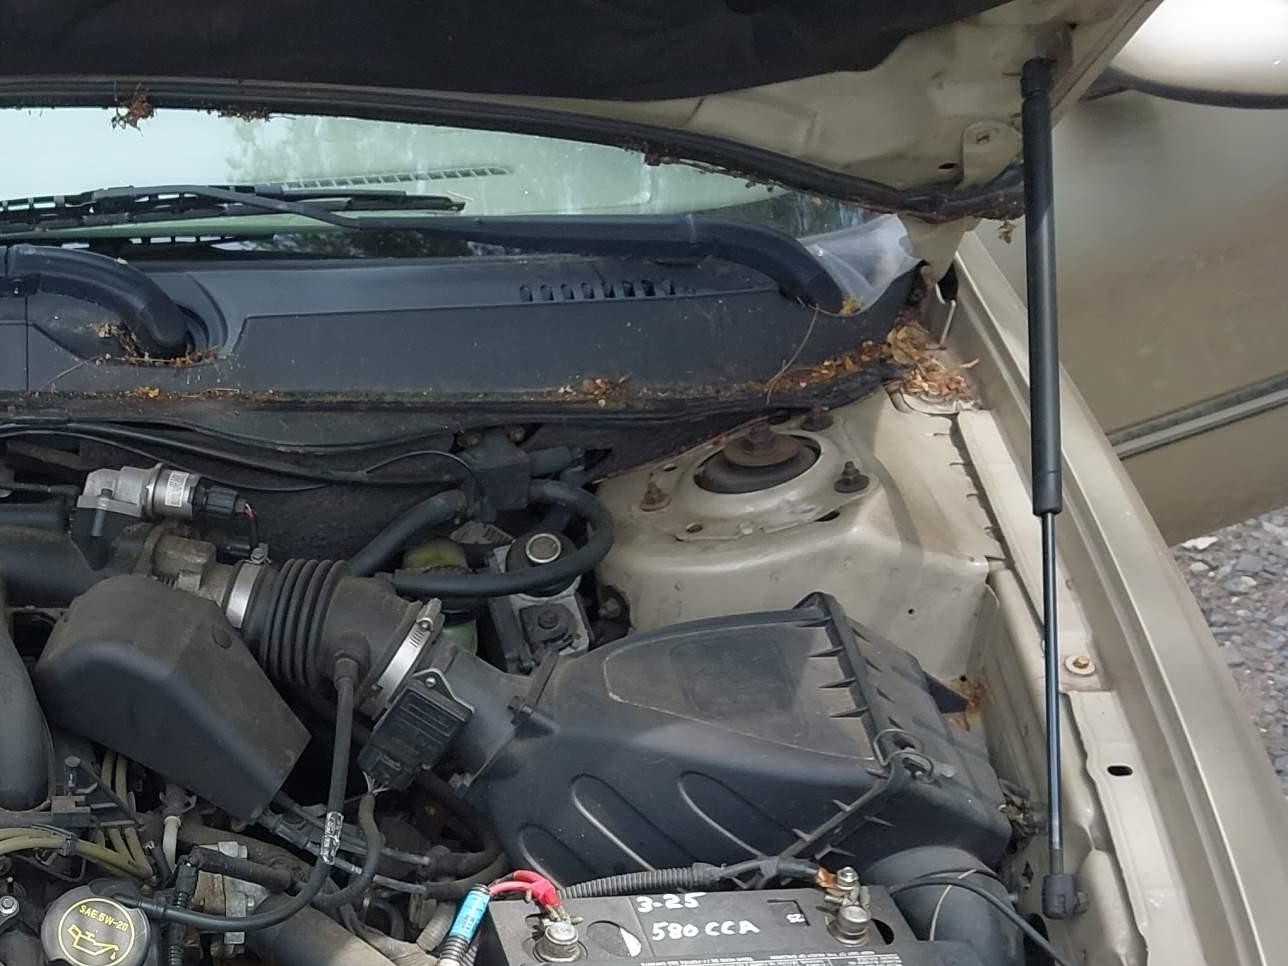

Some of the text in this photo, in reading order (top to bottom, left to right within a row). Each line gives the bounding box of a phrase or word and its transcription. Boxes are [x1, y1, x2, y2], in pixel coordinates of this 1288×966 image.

[636, 892, 707, 913] 3-25
[79, 904, 129, 932] SAE 5W-20
[651, 920, 760, 941] 580 CCA
